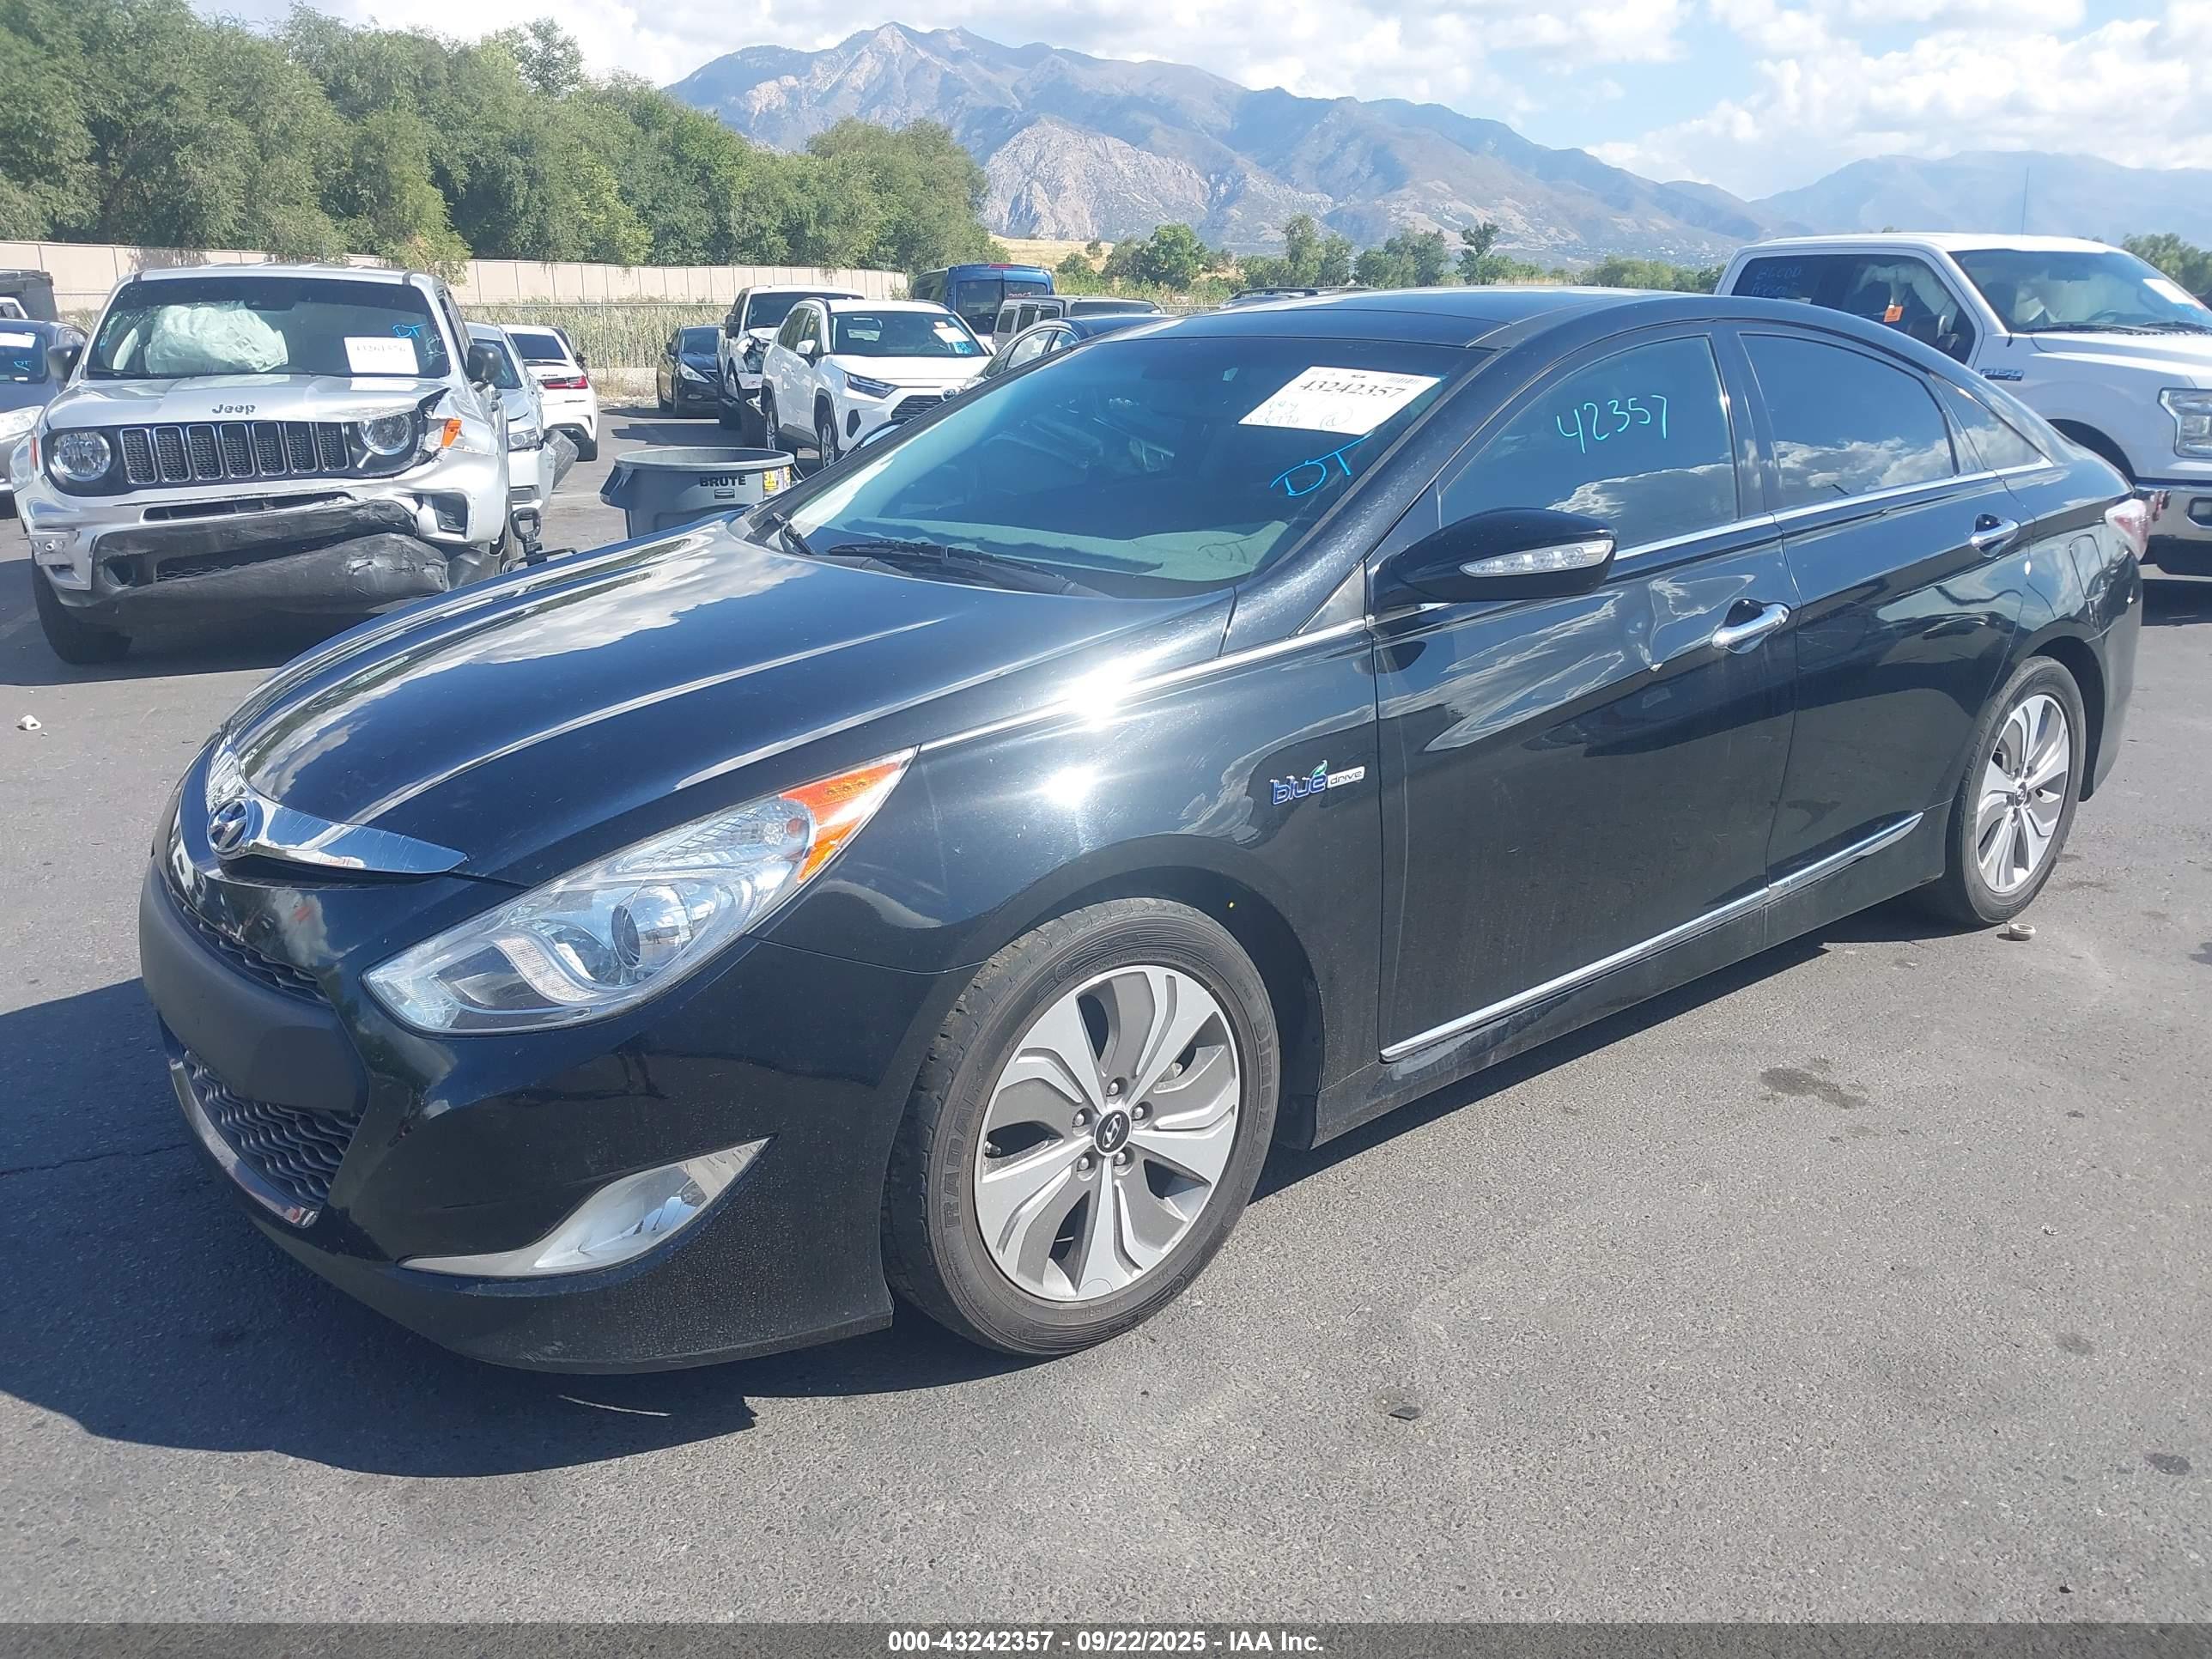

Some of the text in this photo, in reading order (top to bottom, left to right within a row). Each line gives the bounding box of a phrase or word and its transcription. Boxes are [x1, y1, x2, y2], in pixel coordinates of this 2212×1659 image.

[1299, 380, 1408, 398] 43242357
[211, 402, 256, 416] Jeep
[1557, 394, 1668, 454] 42357
[1270, 433, 1374, 496] DT
[700, 475, 747, 487] BRUTE
[1270, 770, 1363, 805] blue drive
